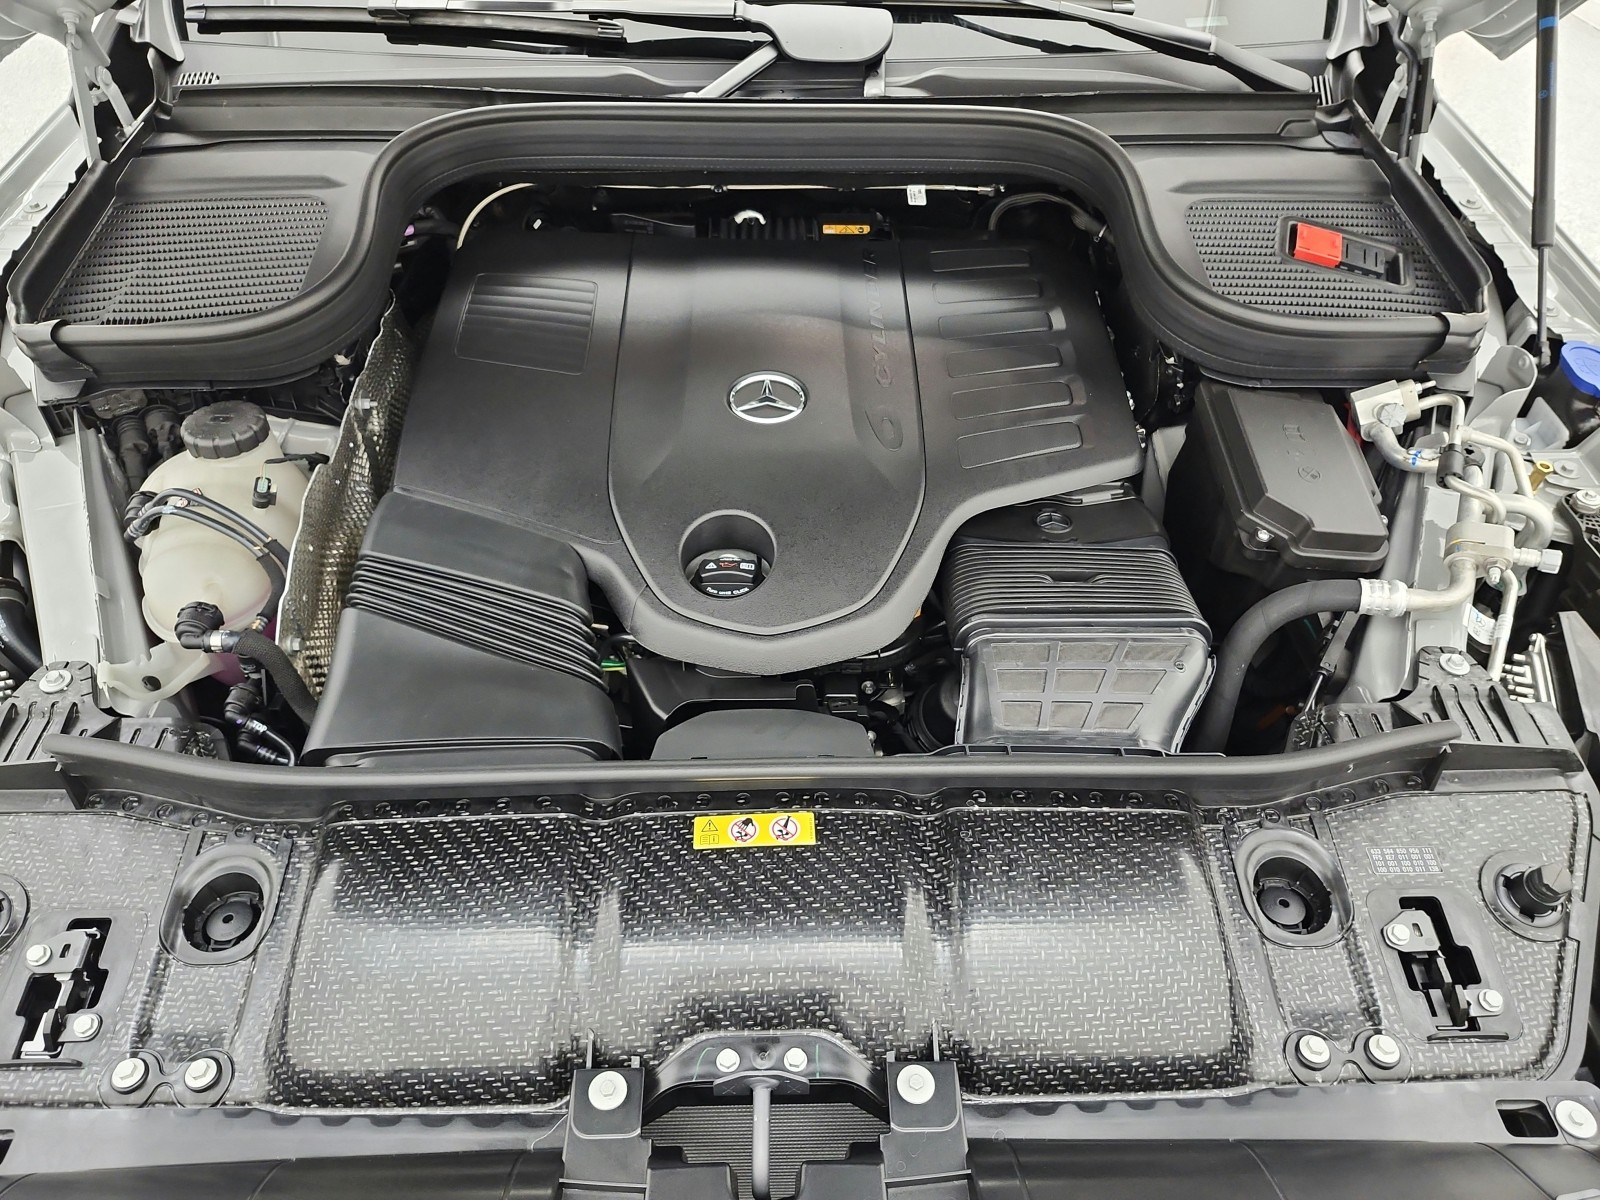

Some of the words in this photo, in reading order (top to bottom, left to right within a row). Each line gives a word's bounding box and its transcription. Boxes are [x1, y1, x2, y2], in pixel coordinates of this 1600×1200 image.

[862, 247, 894, 388] CYLINDER
[706, 586, 718, 594] Turn
[732, 587, 750, 595] CLICK
[252, 719, 268, 733] TOP
